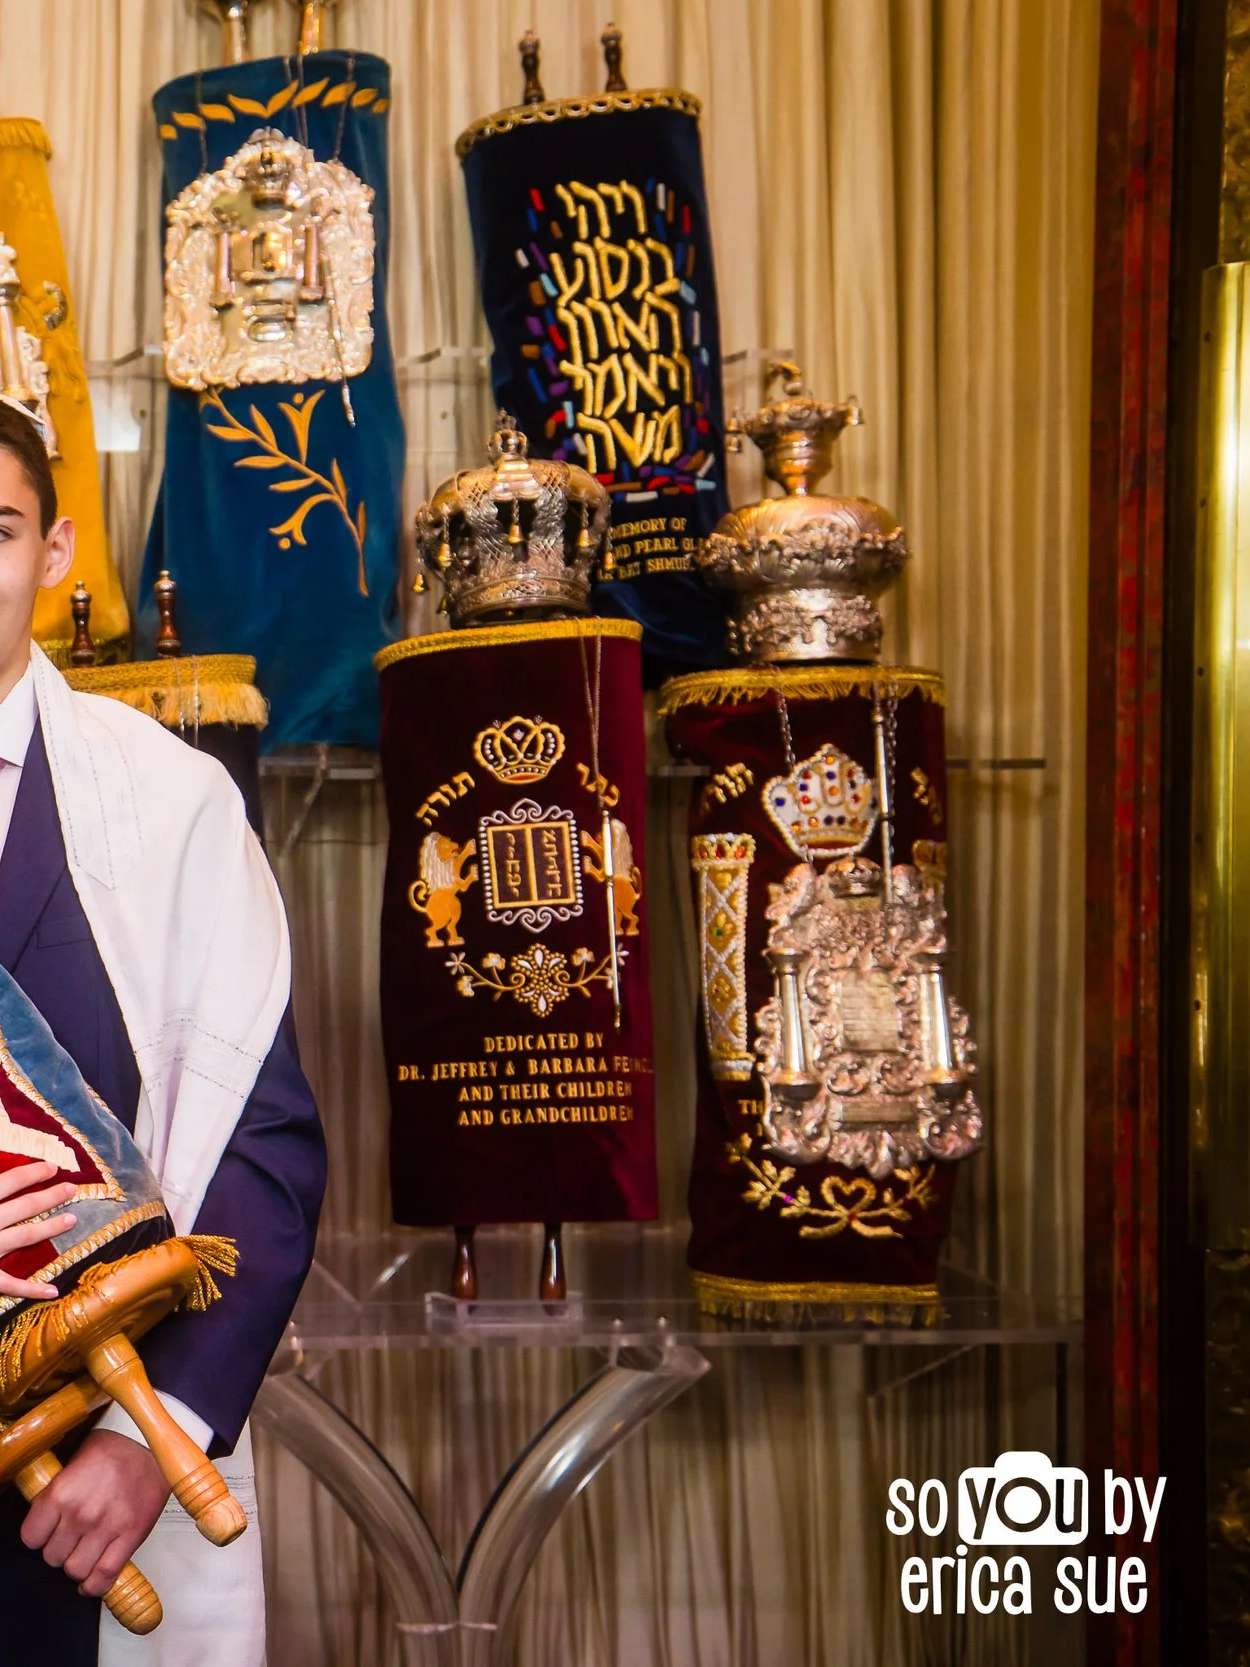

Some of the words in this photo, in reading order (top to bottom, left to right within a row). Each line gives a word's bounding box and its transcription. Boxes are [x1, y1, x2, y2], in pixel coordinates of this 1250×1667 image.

[555, 180, 647, 240] ויהי
[550, 236, 681, 308] בנסוע
[559, 352, 693, 420] ויאמר
[577, 404, 682, 475] משה
[670, 517, 688, 533] OF
[613, 542, 632, 563] ND
[634, 536, 679, 555] PEARL
[681, 536, 706, 552] GL
[414, 771, 476, 827] תורה
[483, 1033, 580, 1054] DEDICATED
[584, 1031, 604, 1049] BY
[398, 1064, 426, 1082] DR.
[431, 1060, 499, 1082] JEFFREY
[504, 1060, 517, 1076] &
[526, 1056, 608, 1077] BARBARA
[458, 1085, 494, 1102] AND
[499, 1083, 551, 1101] THEIR
[555, 1080, 633, 1099] CHILDREN
[458, 1109, 494, 1126] AND
[500, 1105, 634, 1126] GRANDCHILDREN
